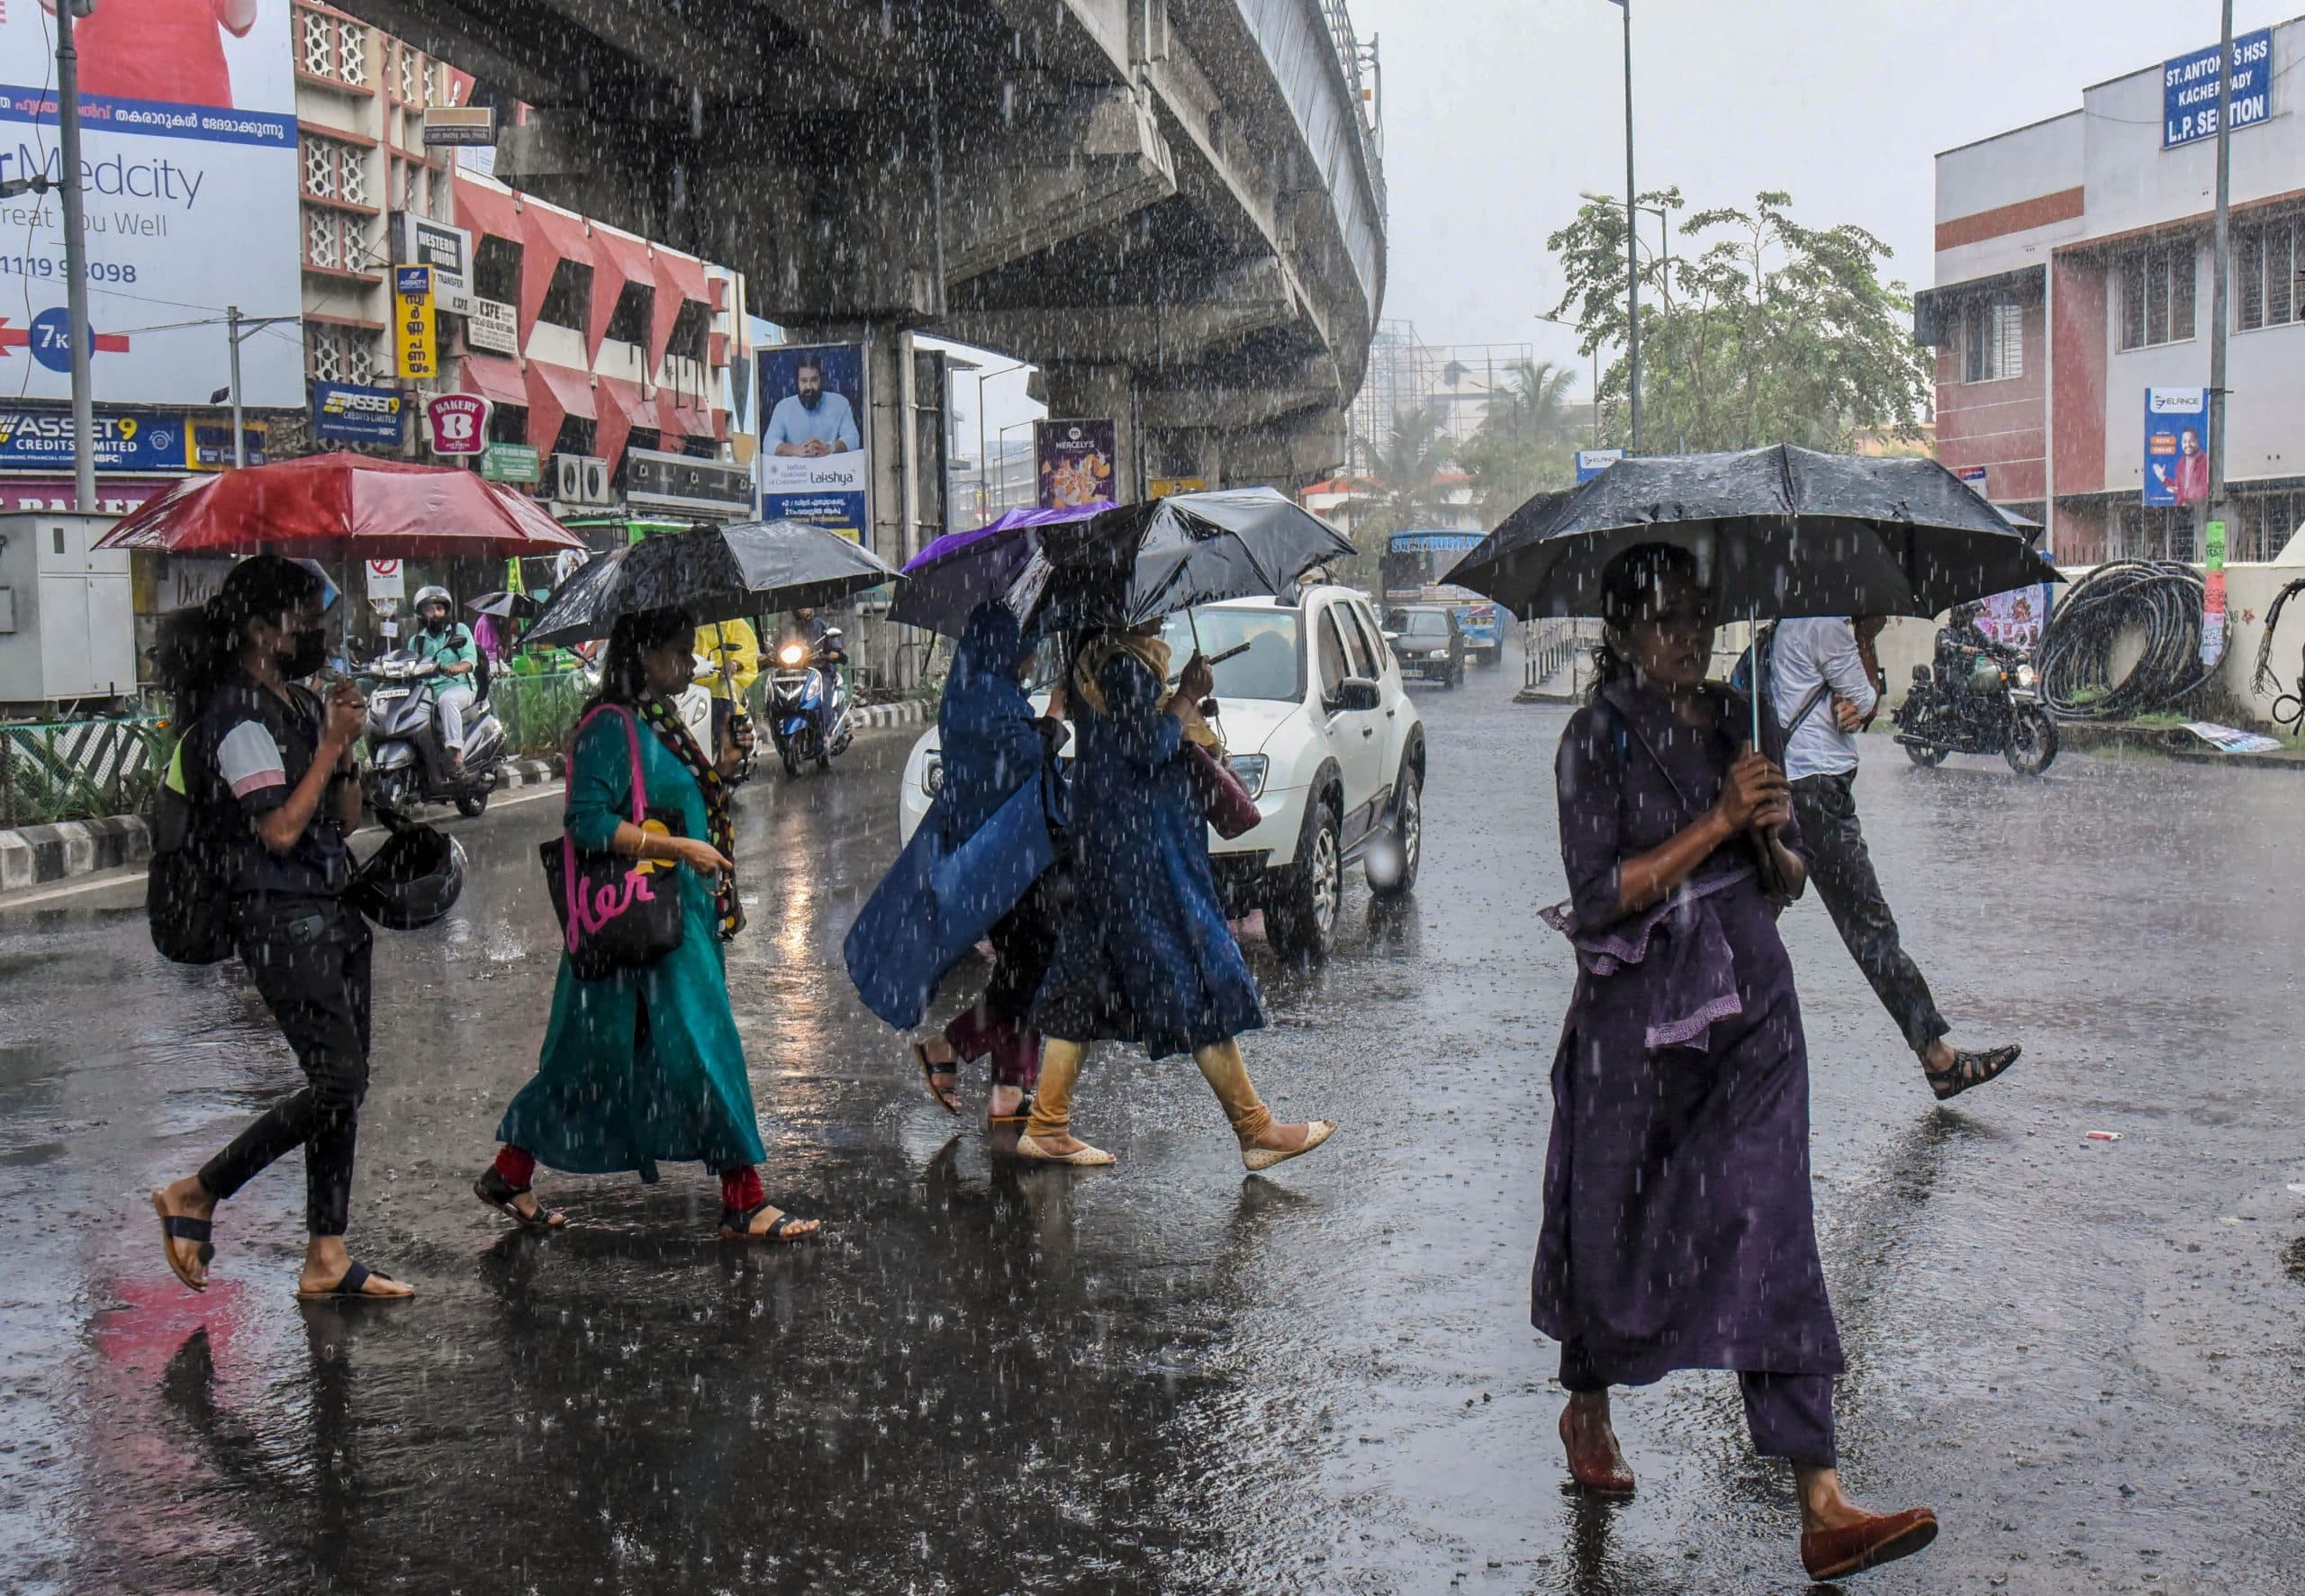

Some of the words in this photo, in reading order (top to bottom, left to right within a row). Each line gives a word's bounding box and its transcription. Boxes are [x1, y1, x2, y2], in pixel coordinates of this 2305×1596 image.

[2183, 42, 2241, 82] ANTON'S
[2244, 41, 2267, 63] HSS
[2178, 70, 2253, 106] KACHERADY
[115, 109, 198, 130] തകരാറുകൾ
[202, 117, 284, 139] ഭേദമാക്കുന്നു
[2168, 115, 2194, 143] L.P.
[2197, 95, 2264, 134] SETION
[1, 205, 54, 228] reat
[114, 212, 167, 237] Well
[419, 230, 456, 252] WESTERN
[430, 248, 456, 267] UNION
[438, 273, 464, 288] TRANSFER
[452, 297, 468, 310] KSFE
[480, 300, 501, 320] KSFE
[435, 400, 478, 413] BAKERY
[15, 439, 75, 450] CREDITS
[93, 440, 137, 453] MITED
[94, 453, 122, 464] NBFC)
[810, 471, 854, 486] Lakshya
